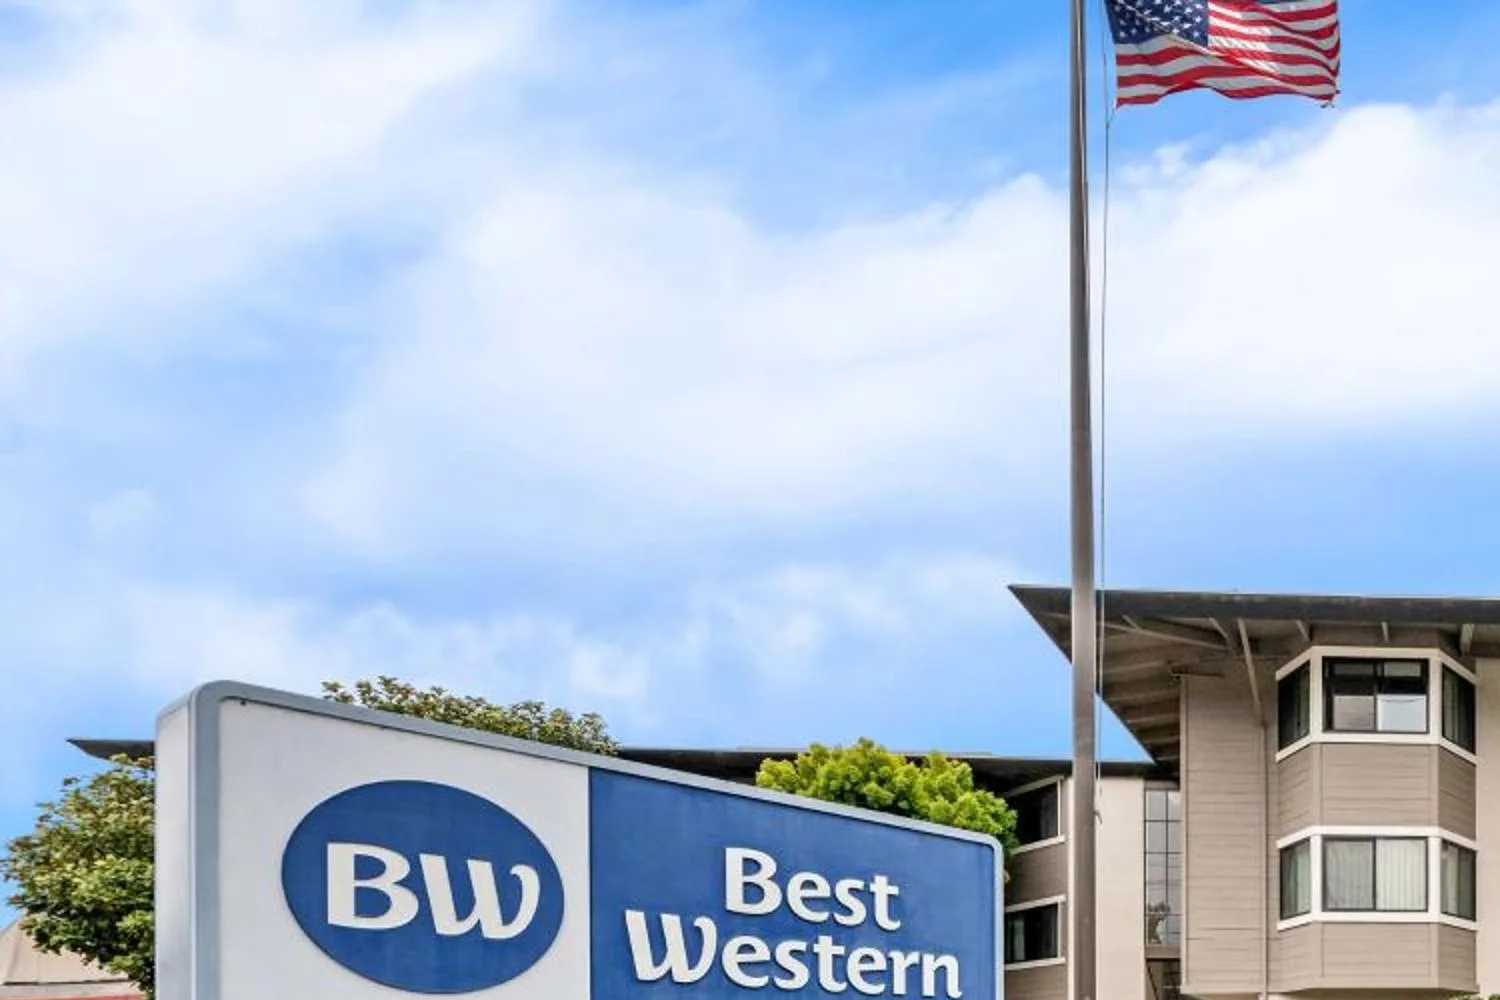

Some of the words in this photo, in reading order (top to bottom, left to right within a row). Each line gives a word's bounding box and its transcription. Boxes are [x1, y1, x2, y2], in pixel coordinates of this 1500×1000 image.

[327, 843, 540, 939] BW
[725, 846, 901, 931] Best
[625, 909, 963, 999] Western
